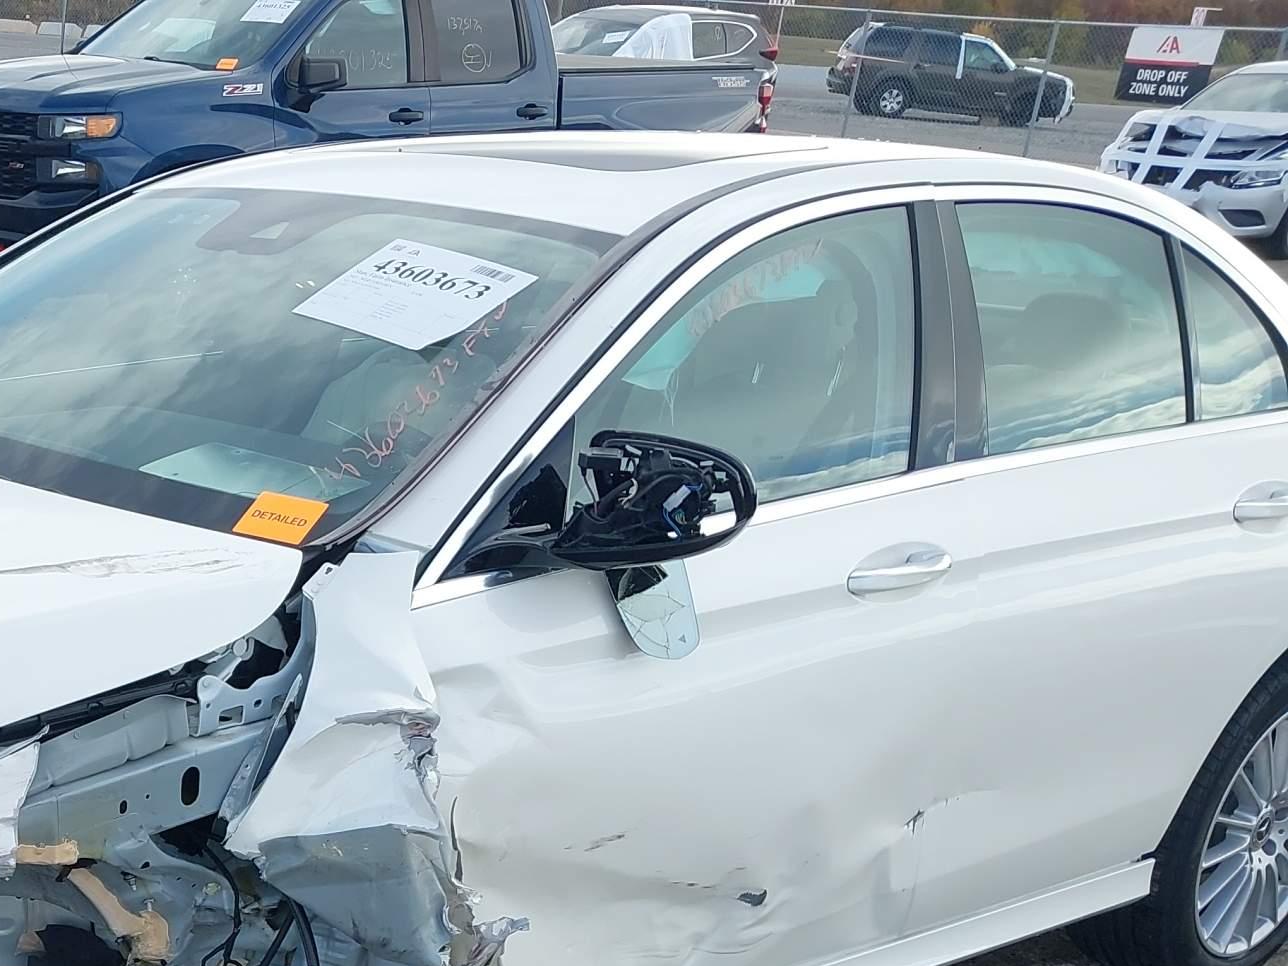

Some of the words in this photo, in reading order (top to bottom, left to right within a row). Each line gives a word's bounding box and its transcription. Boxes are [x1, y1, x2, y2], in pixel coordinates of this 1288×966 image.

[1136, 68, 1165, 82] DROP
[1167, 71, 1189, 83] OFF
[1128, 82, 1157, 96] ZONE
[1158, 84, 1189, 98] ONLY
[373, 258, 492, 301] 43603673
[251, 509, 309, 528] DETAILED
